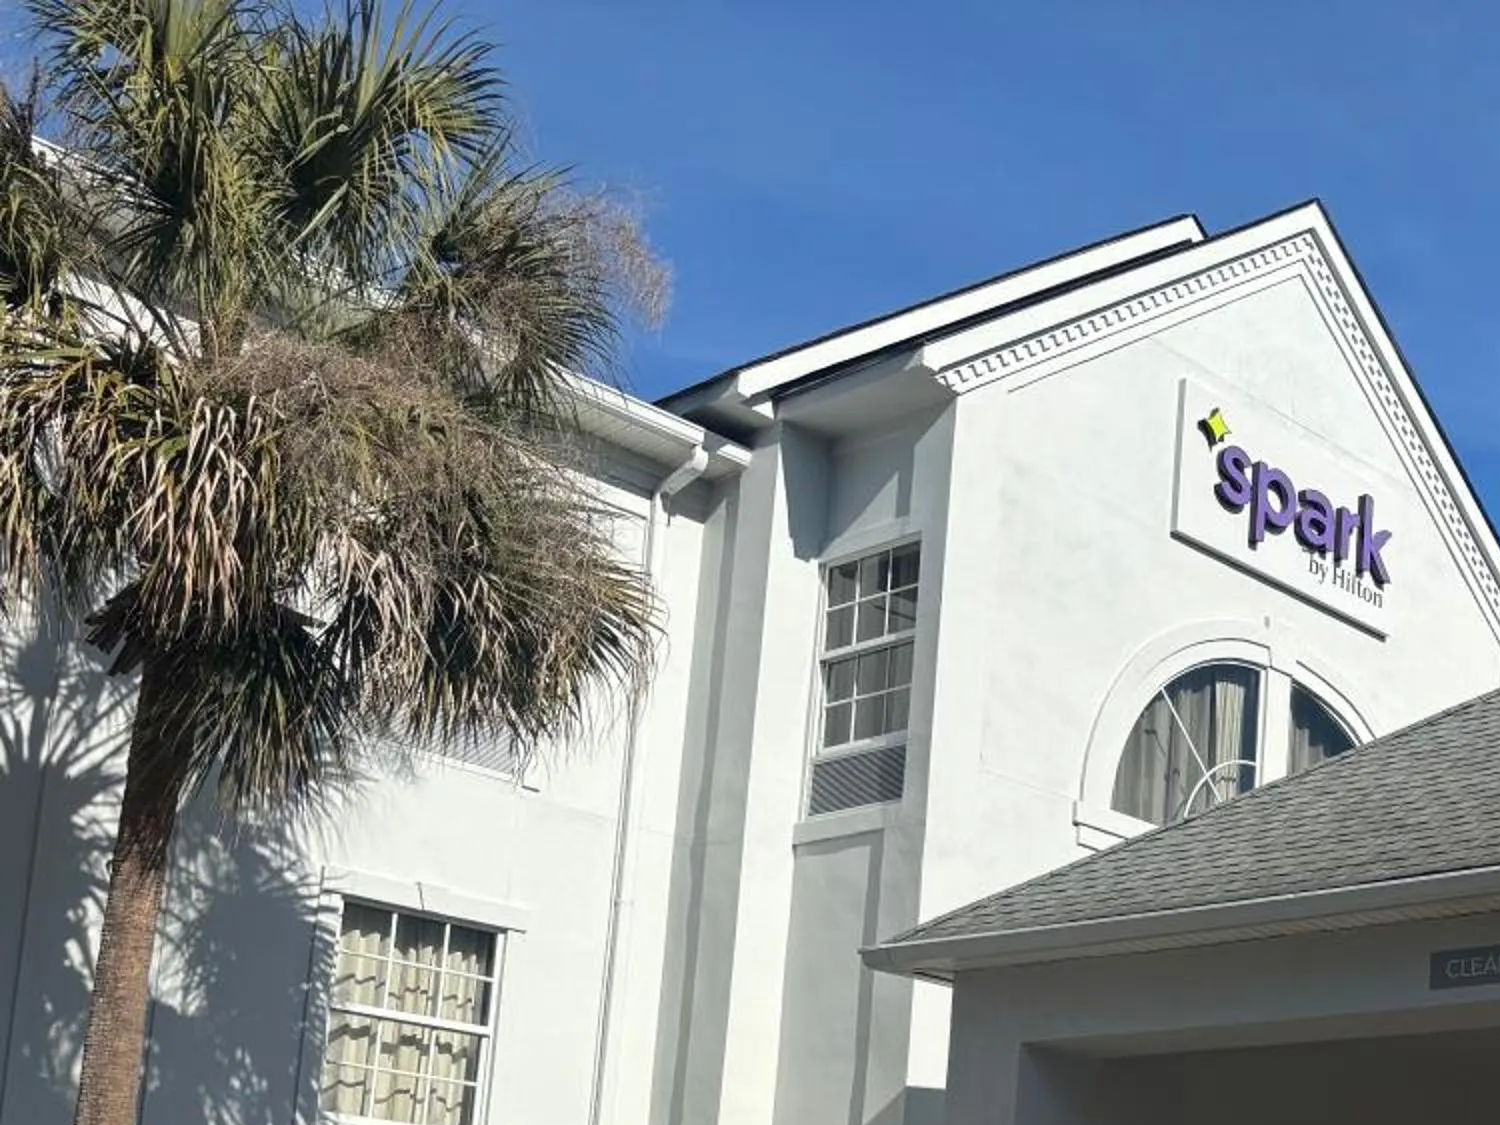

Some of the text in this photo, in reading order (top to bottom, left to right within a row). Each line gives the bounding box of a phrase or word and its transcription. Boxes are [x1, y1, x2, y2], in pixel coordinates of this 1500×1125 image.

[1214, 445, 1392, 590] spark
[1308, 552, 1383, 609] by Hilton
